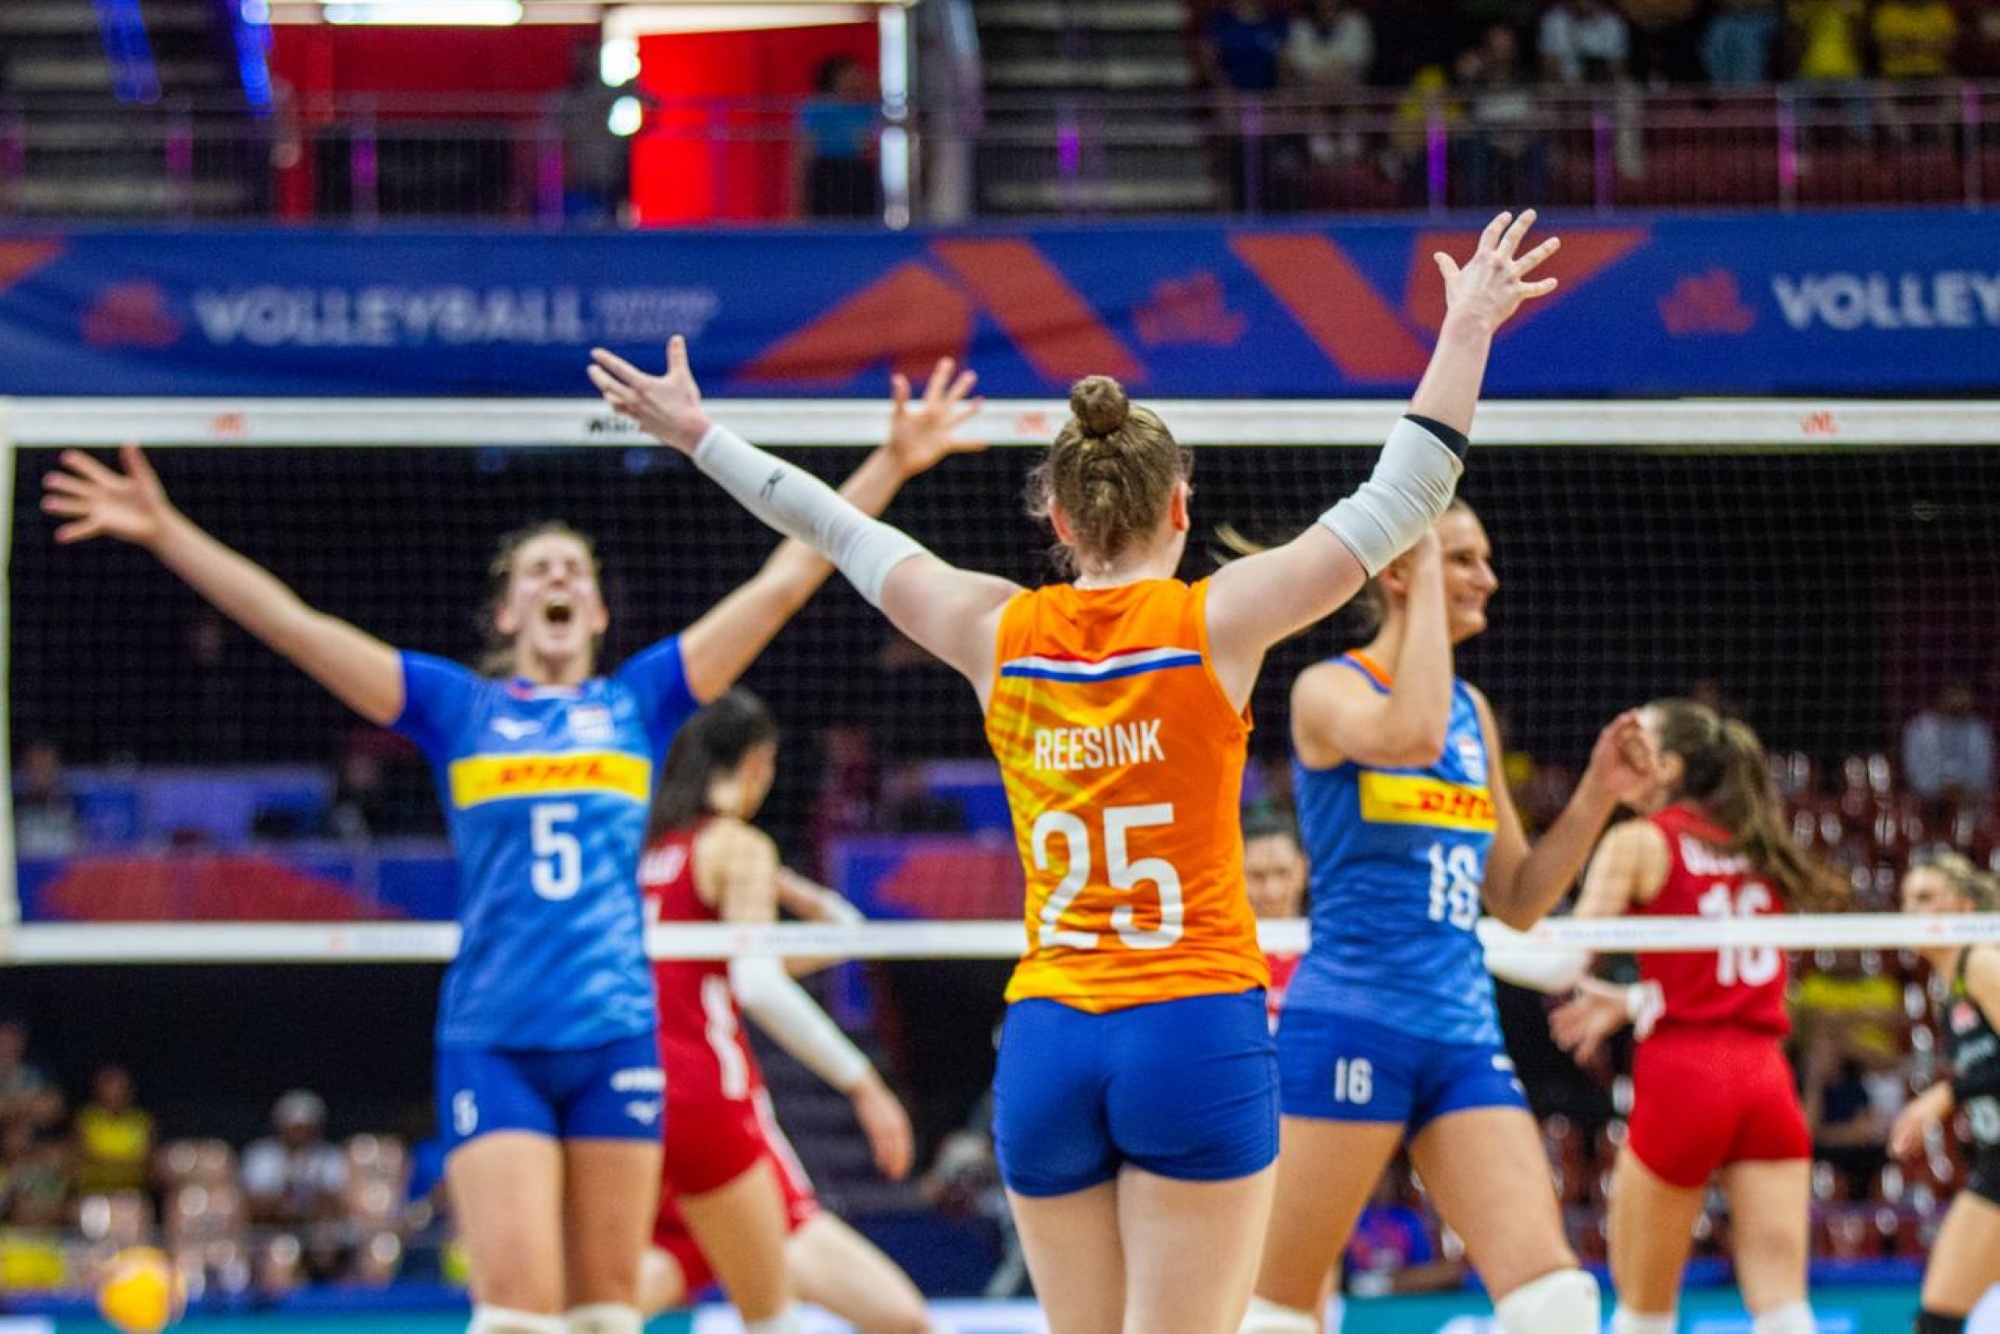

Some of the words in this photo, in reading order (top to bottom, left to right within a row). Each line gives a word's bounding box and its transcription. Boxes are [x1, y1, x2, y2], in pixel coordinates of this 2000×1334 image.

[197, 288, 586, 345] VOLLEYBALL
[1034, 719, 1164, 770] REESINK
[530, 803, 582, 900] 5
[1032, 803, 1184, 949] 25
[1698, 882, 1781, 987] 16
[1335, 1057, 1373, 1104] 16
